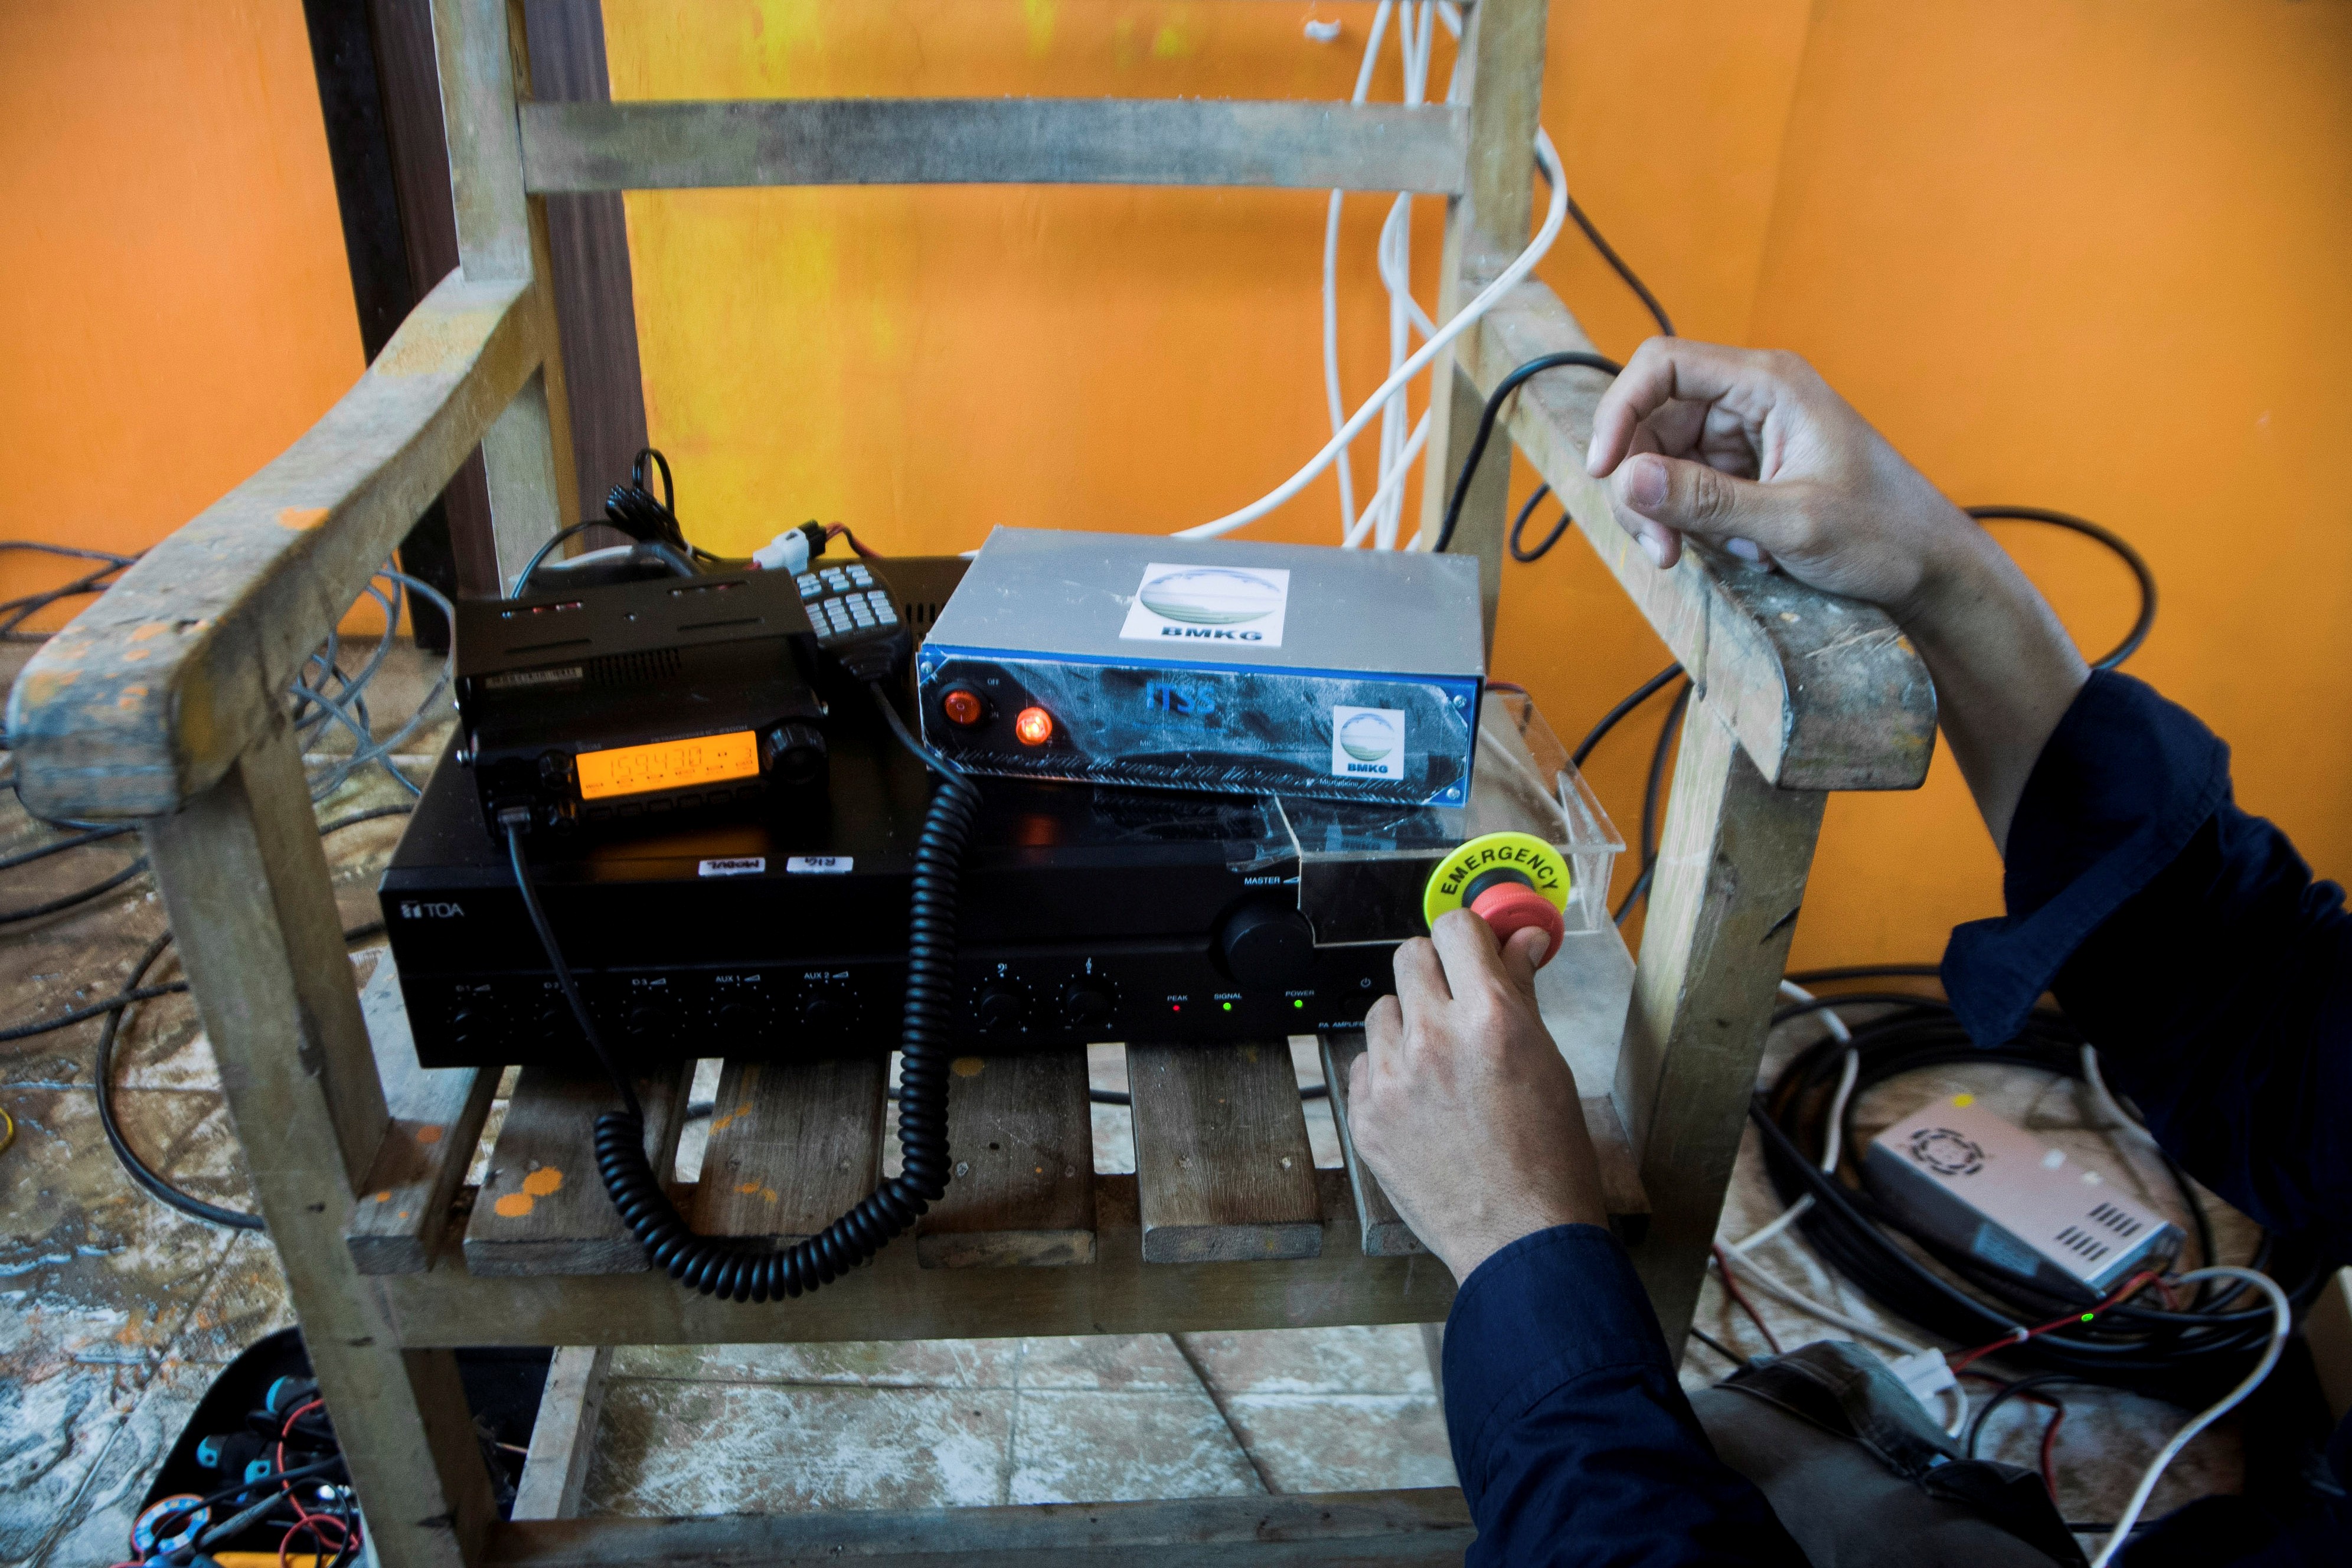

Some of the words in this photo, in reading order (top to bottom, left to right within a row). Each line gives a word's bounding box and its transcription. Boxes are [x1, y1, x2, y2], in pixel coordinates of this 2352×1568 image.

[1161, 625, 1263, 642] BMKG
[1347, 763, 1388, 774] BMKG
[1440, 846, 1559, 896] EMERGENCY
[1244, 876, 1280, 885] MASTER
[423, 902, 466, 918] TOA
[715, 975, 734, 983] AUX
[803, 972, 822, 980] AUX
